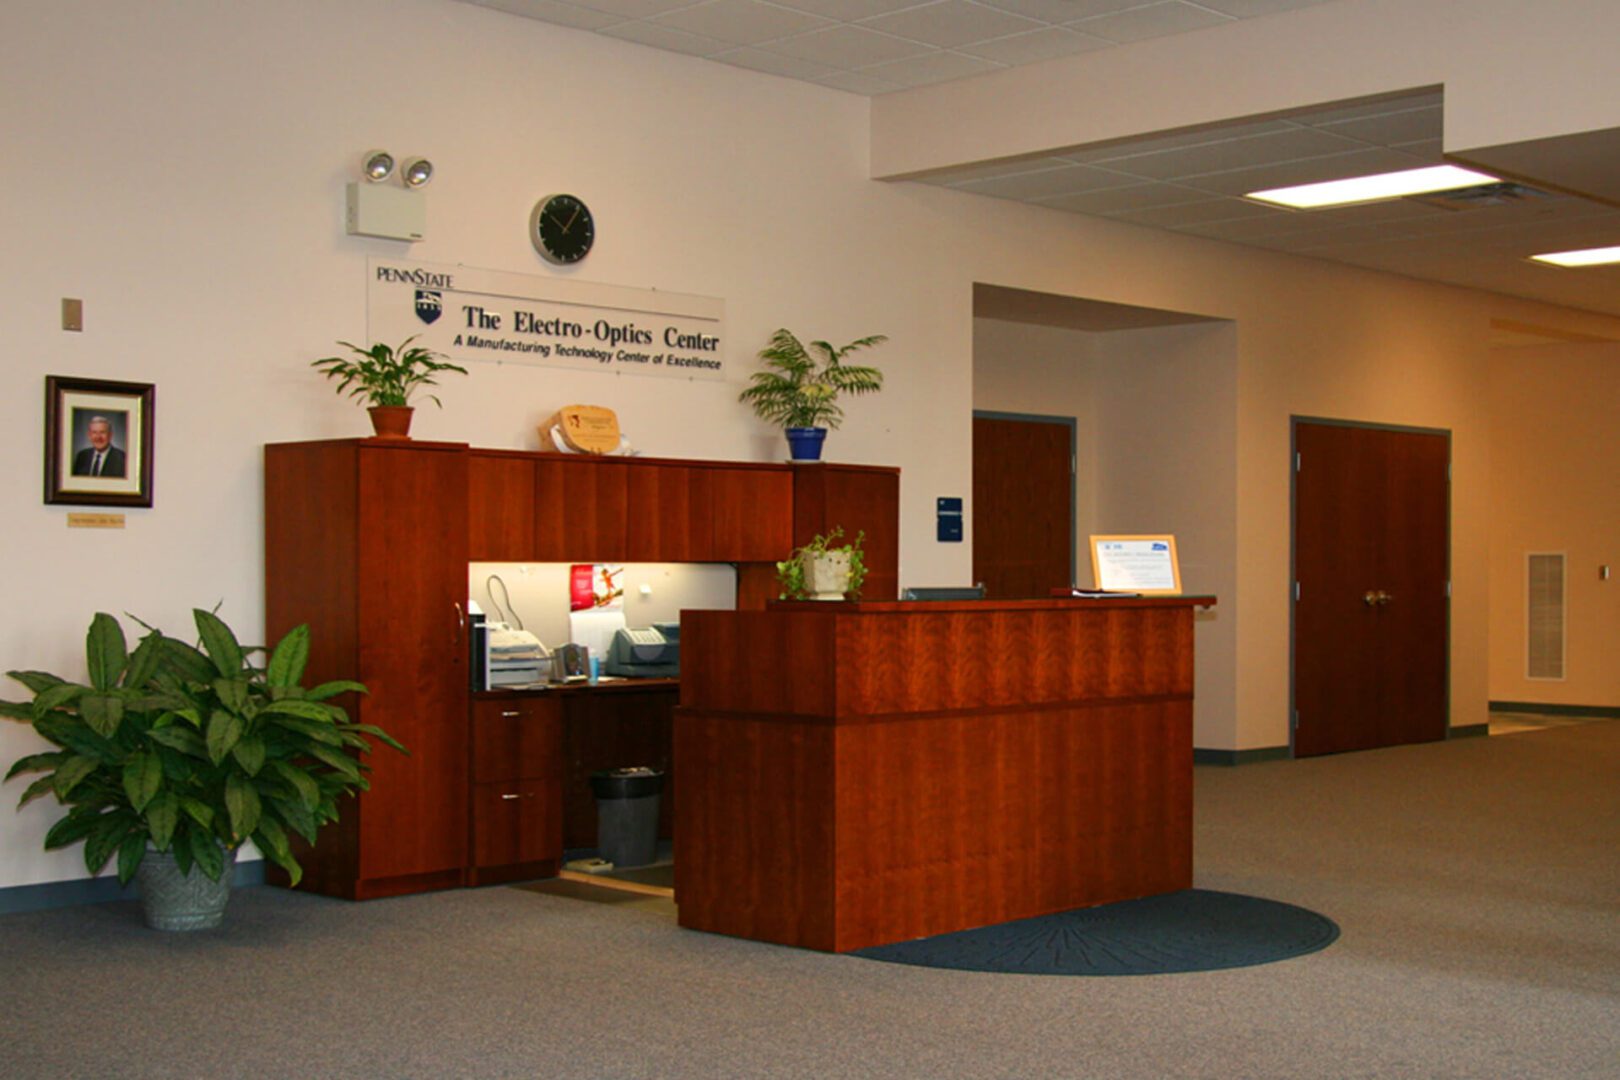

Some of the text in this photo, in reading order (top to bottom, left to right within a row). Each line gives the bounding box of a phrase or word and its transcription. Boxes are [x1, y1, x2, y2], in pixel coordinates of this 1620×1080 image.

[462, 305, 501, 331] The
[664, 327, 720, 352] Center
[453, 334, 722, 370] A Manufacturing Technology Center of Excellence
